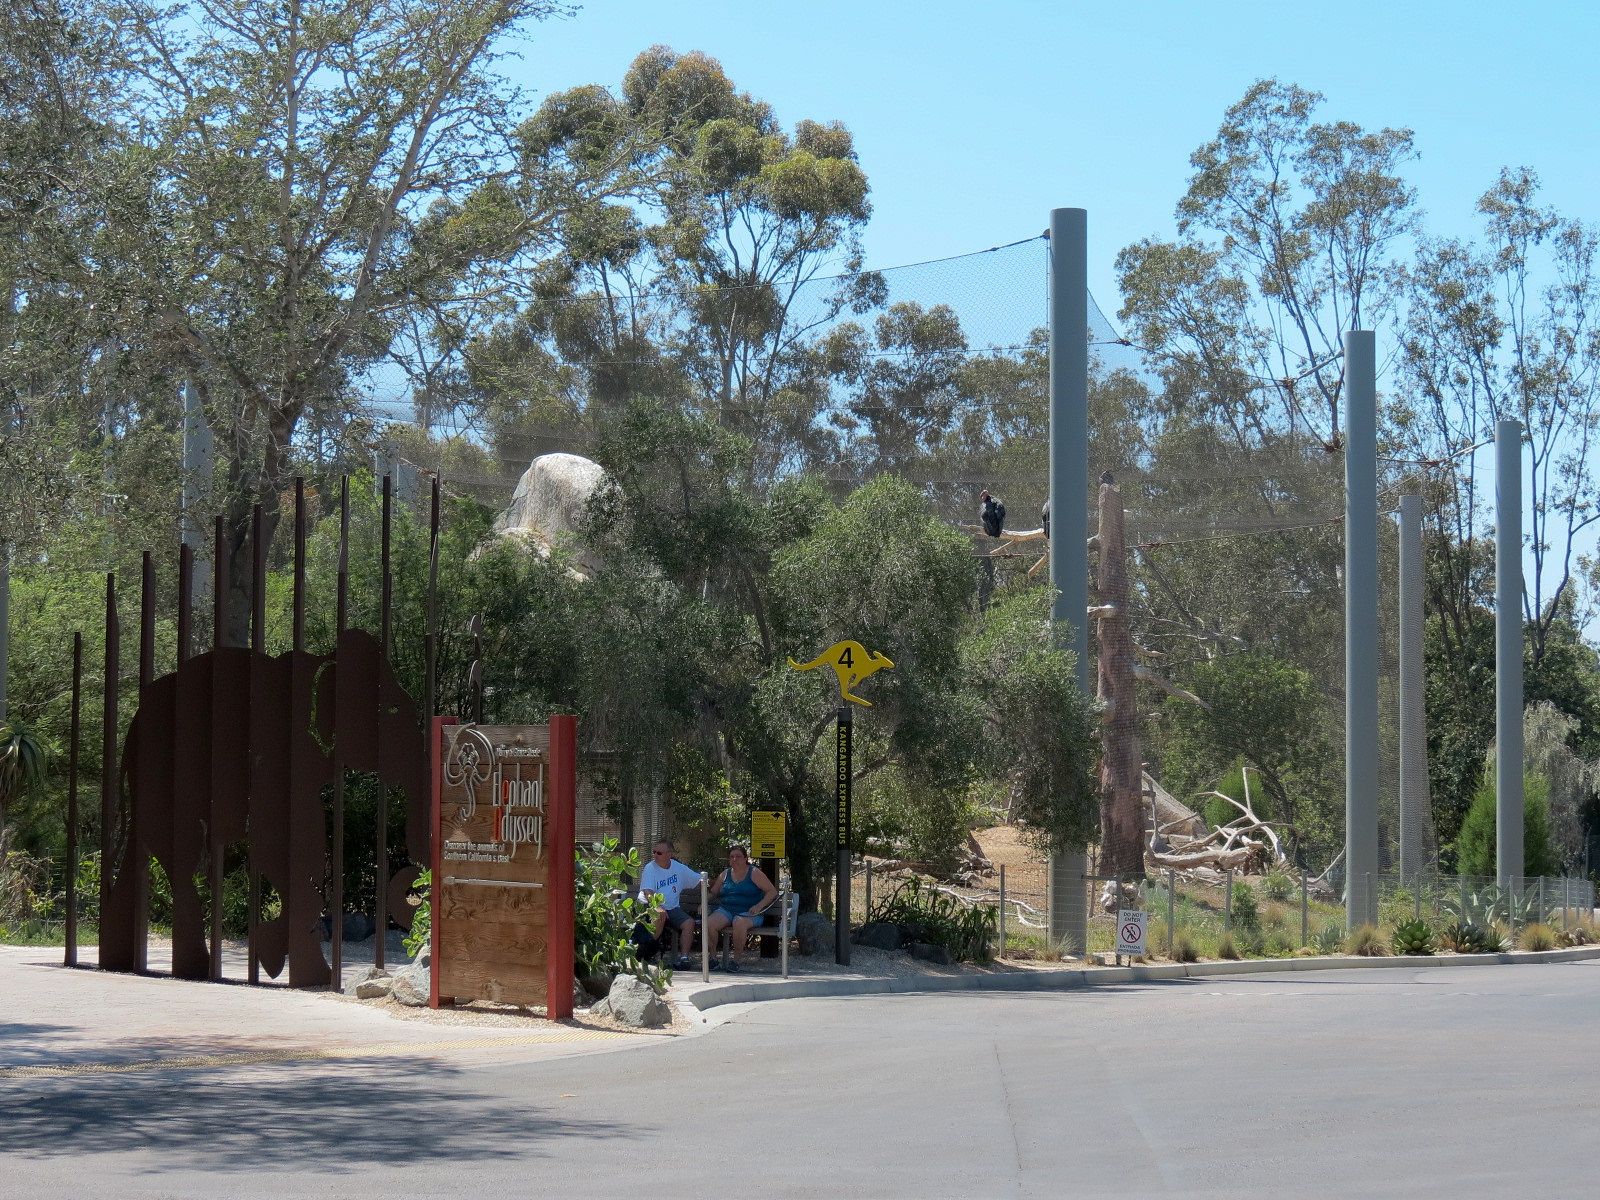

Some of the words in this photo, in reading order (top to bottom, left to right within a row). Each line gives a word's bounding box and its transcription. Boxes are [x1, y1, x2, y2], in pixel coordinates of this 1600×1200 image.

[837, 647, 854, 669] 4
[839, 726, 847, 780] KANGAROO
[492, 763, 544, 814] Elephant
[493, 803, 543, 860] Odyssey
[838, 826, 846, 845] BUS
[444, 839, 467, 850] Discover
[467, 841, 477, 851] the
[477, 842, 498, 852] animals
[498, 843, 506, 852] of
[444, 851, 468, 860] Southern
[497, 854, 510, 864] past
